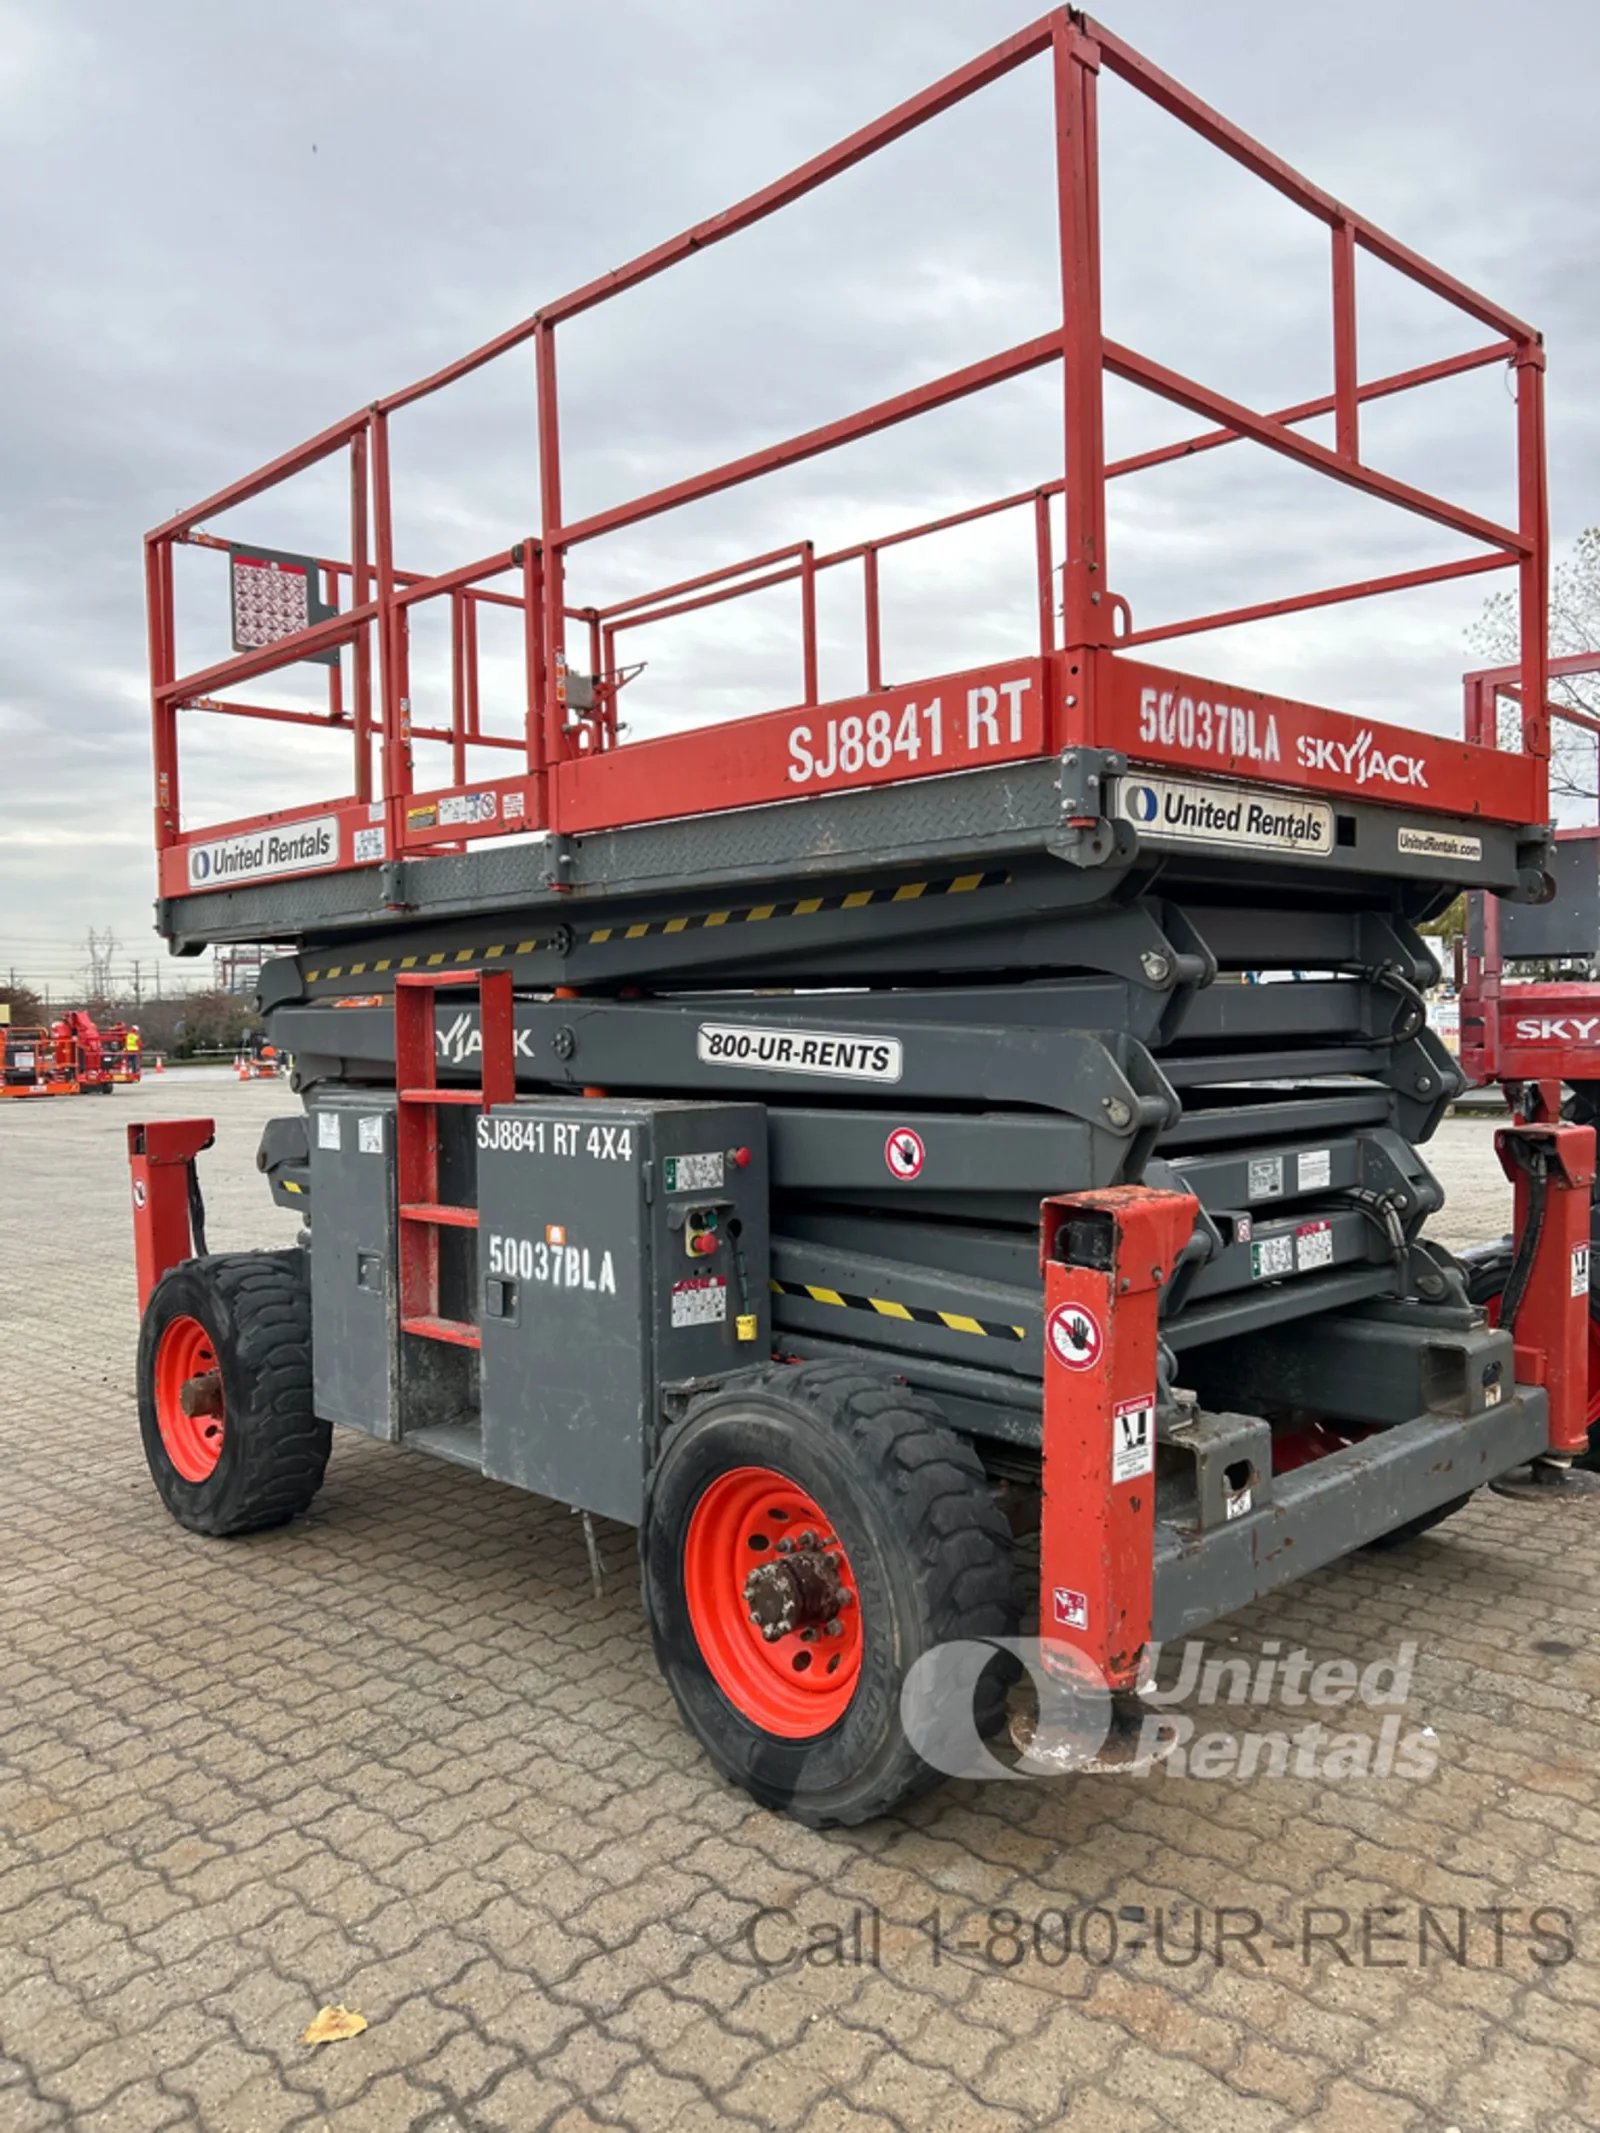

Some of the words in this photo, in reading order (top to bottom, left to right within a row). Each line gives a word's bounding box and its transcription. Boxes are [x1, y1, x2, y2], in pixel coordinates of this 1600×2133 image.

[788, 697, 943, 783] SJ8841
[966, 677, 1032, 750] RT
[1139, 688, 1282, 763] 50037BLA
[1296, 728, 1429, 789] SKYJACK
[1163, 793, 1241, 832] United
[1246, 802, 1322, 842] Rentals
[213, 839, 265, 875] United
[267, 827, 331, 864] Rentals
[1399, 832, 1481, 857] UnitedRentals.com
[435, 1012, 536, 1064] YJAK
[708, 1033, 890, 1072] 800-UR-RENTS
[1516, 1017, 1600, 1044] SKY
[476, 1117, 545, 1153] SJ8841
[553, 1122, 581, 1157] RT
[586, 1126, 633, 1162] 4X4
[489, 1234, 617, 1294] 50037BLA
